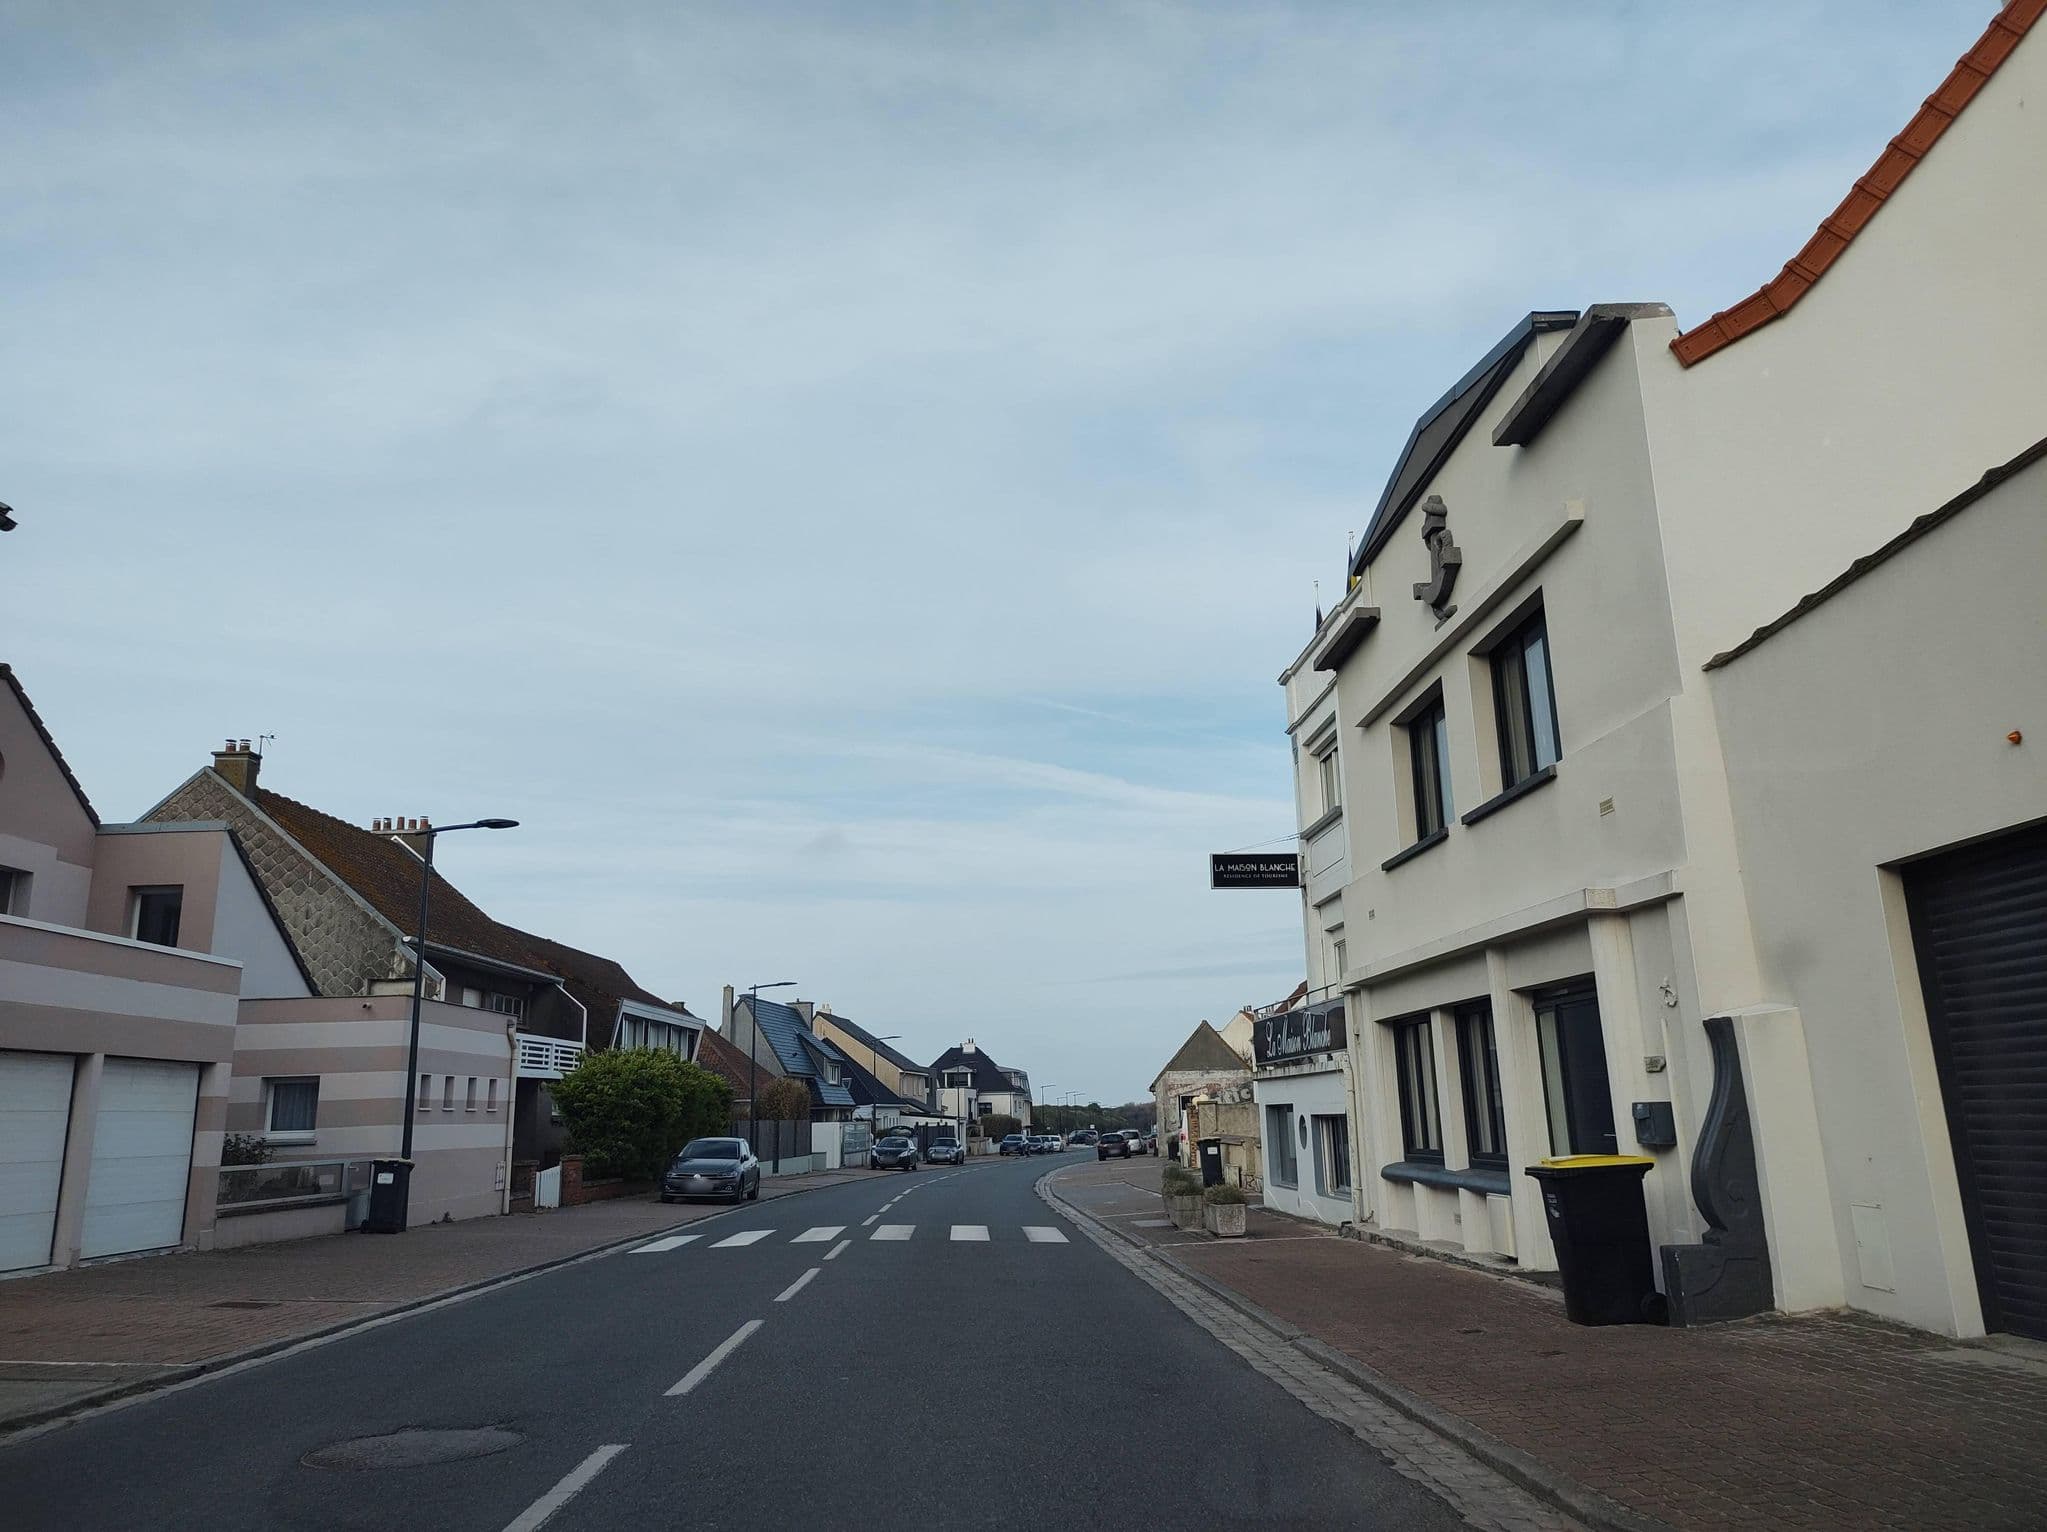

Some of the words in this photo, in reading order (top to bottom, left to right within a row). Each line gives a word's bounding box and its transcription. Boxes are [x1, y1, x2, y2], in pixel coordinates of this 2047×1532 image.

[1214, 863, 1225, 872] LA
[1227, 863, 1257, 872] MAISON
[1260, 863, 1296, 872] BLANCHE
[1276, 1014, 1301, 1056] Maison
